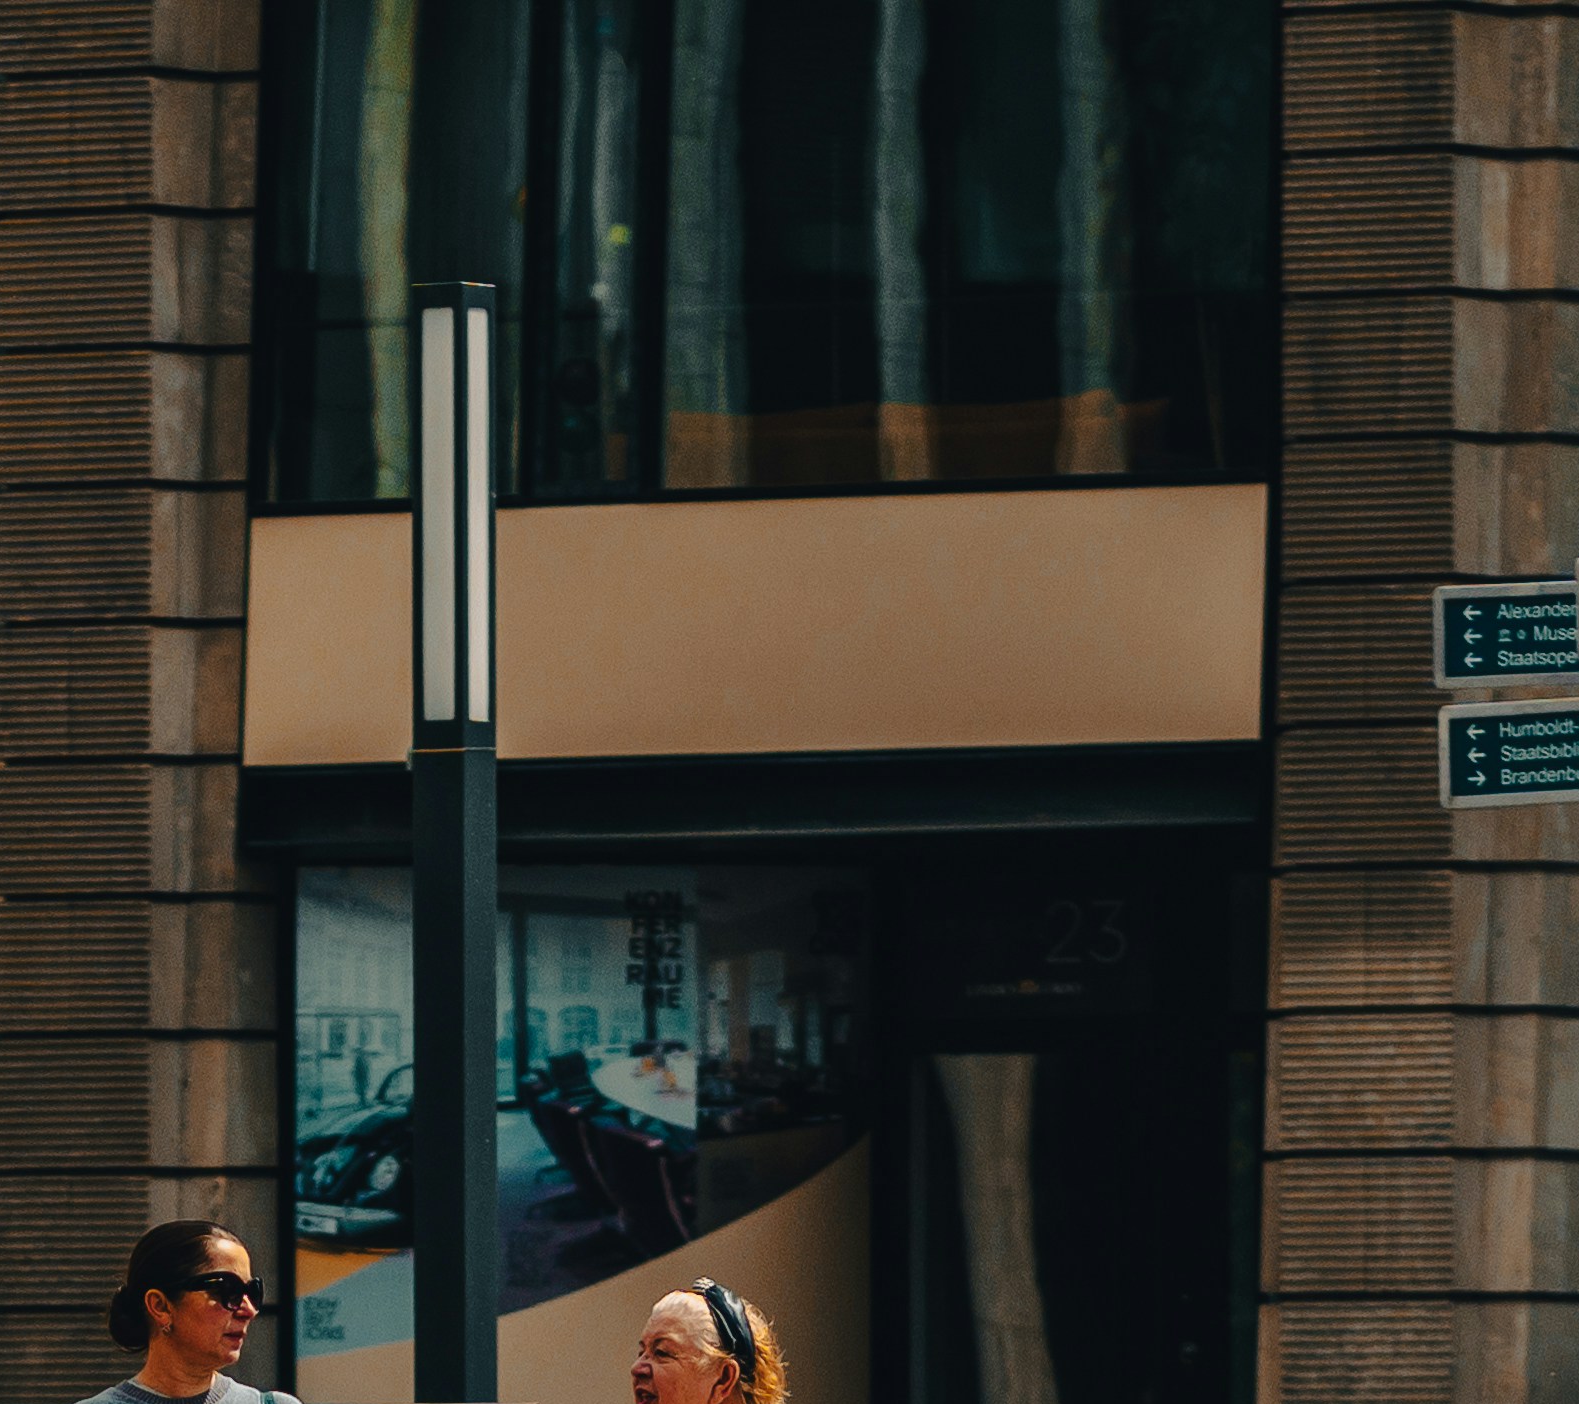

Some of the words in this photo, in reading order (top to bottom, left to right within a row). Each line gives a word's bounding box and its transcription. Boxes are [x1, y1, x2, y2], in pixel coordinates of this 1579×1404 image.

[1496, 602, 1577, 619] Alexander
[1533, 625, 1578, 641] Muse
[1497, 650, 1579, 668] Staatsope
[1046, 899, 1128, 964] 23
